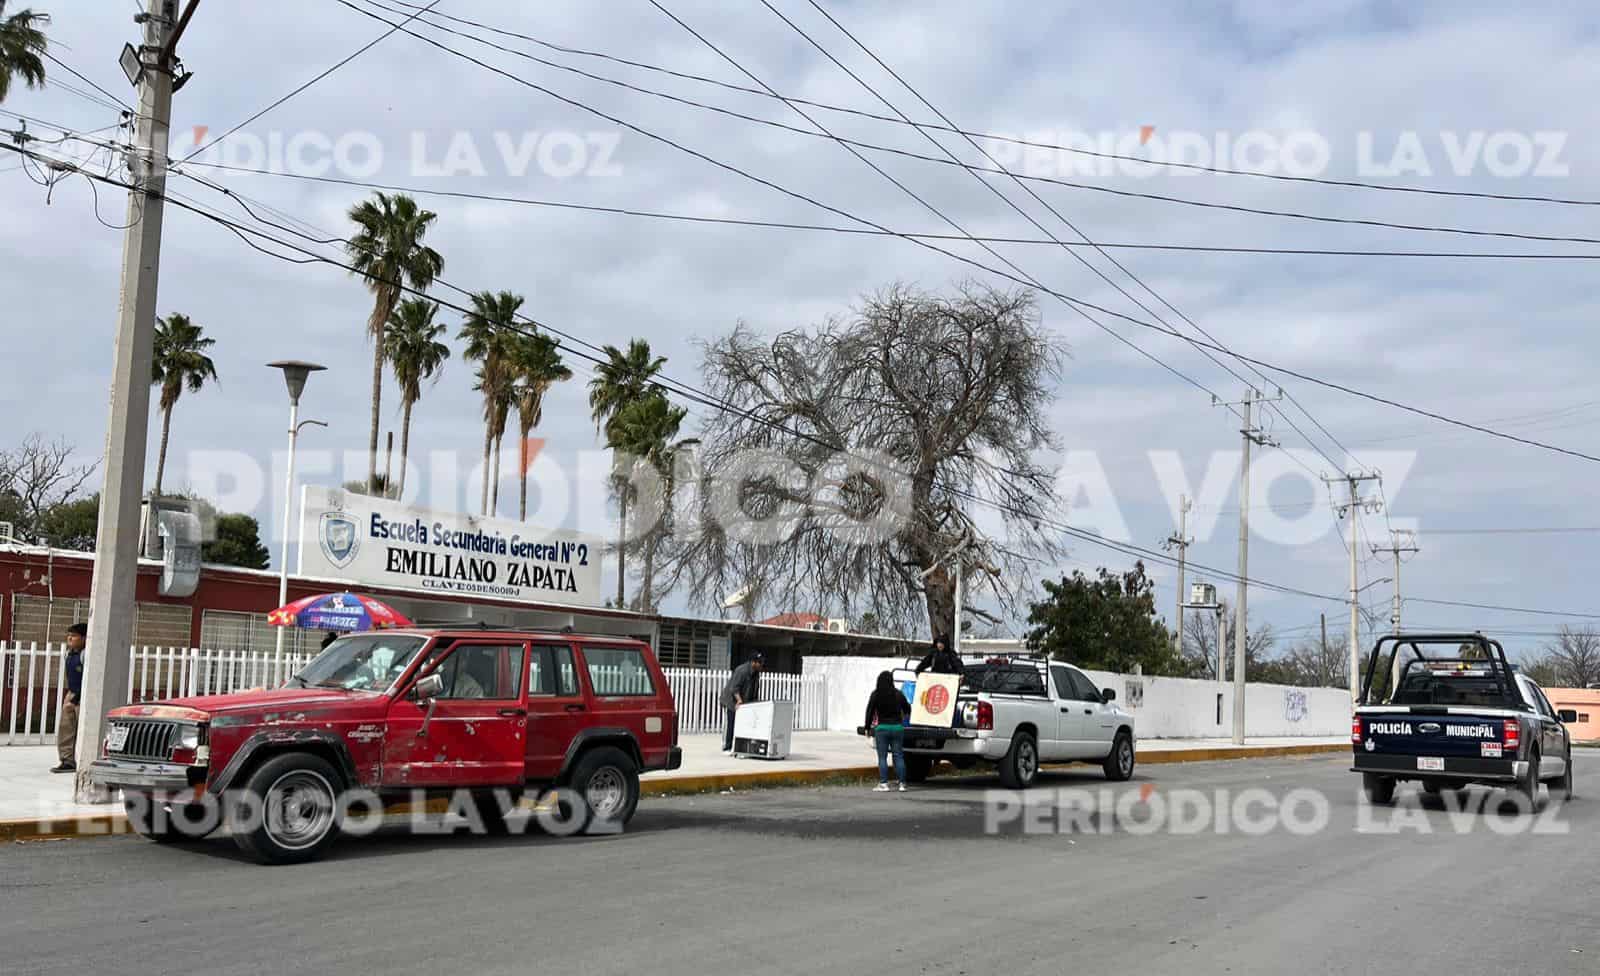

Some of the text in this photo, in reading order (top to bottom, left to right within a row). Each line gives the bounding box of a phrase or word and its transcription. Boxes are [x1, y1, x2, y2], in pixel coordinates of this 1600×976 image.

[370, 512, 427, 544] Escuela
[433, 522, 506, 555] Secundaria
[511, 534, 559, 562] General
[577, 543, 588, 566] 2
[385, 546, 578, 593] EMILIANO ZAPATA
[422, 579, 465, 591] CLAVE
[1369, 721, 1495, 738] POLICÍA MUNICIPAL
